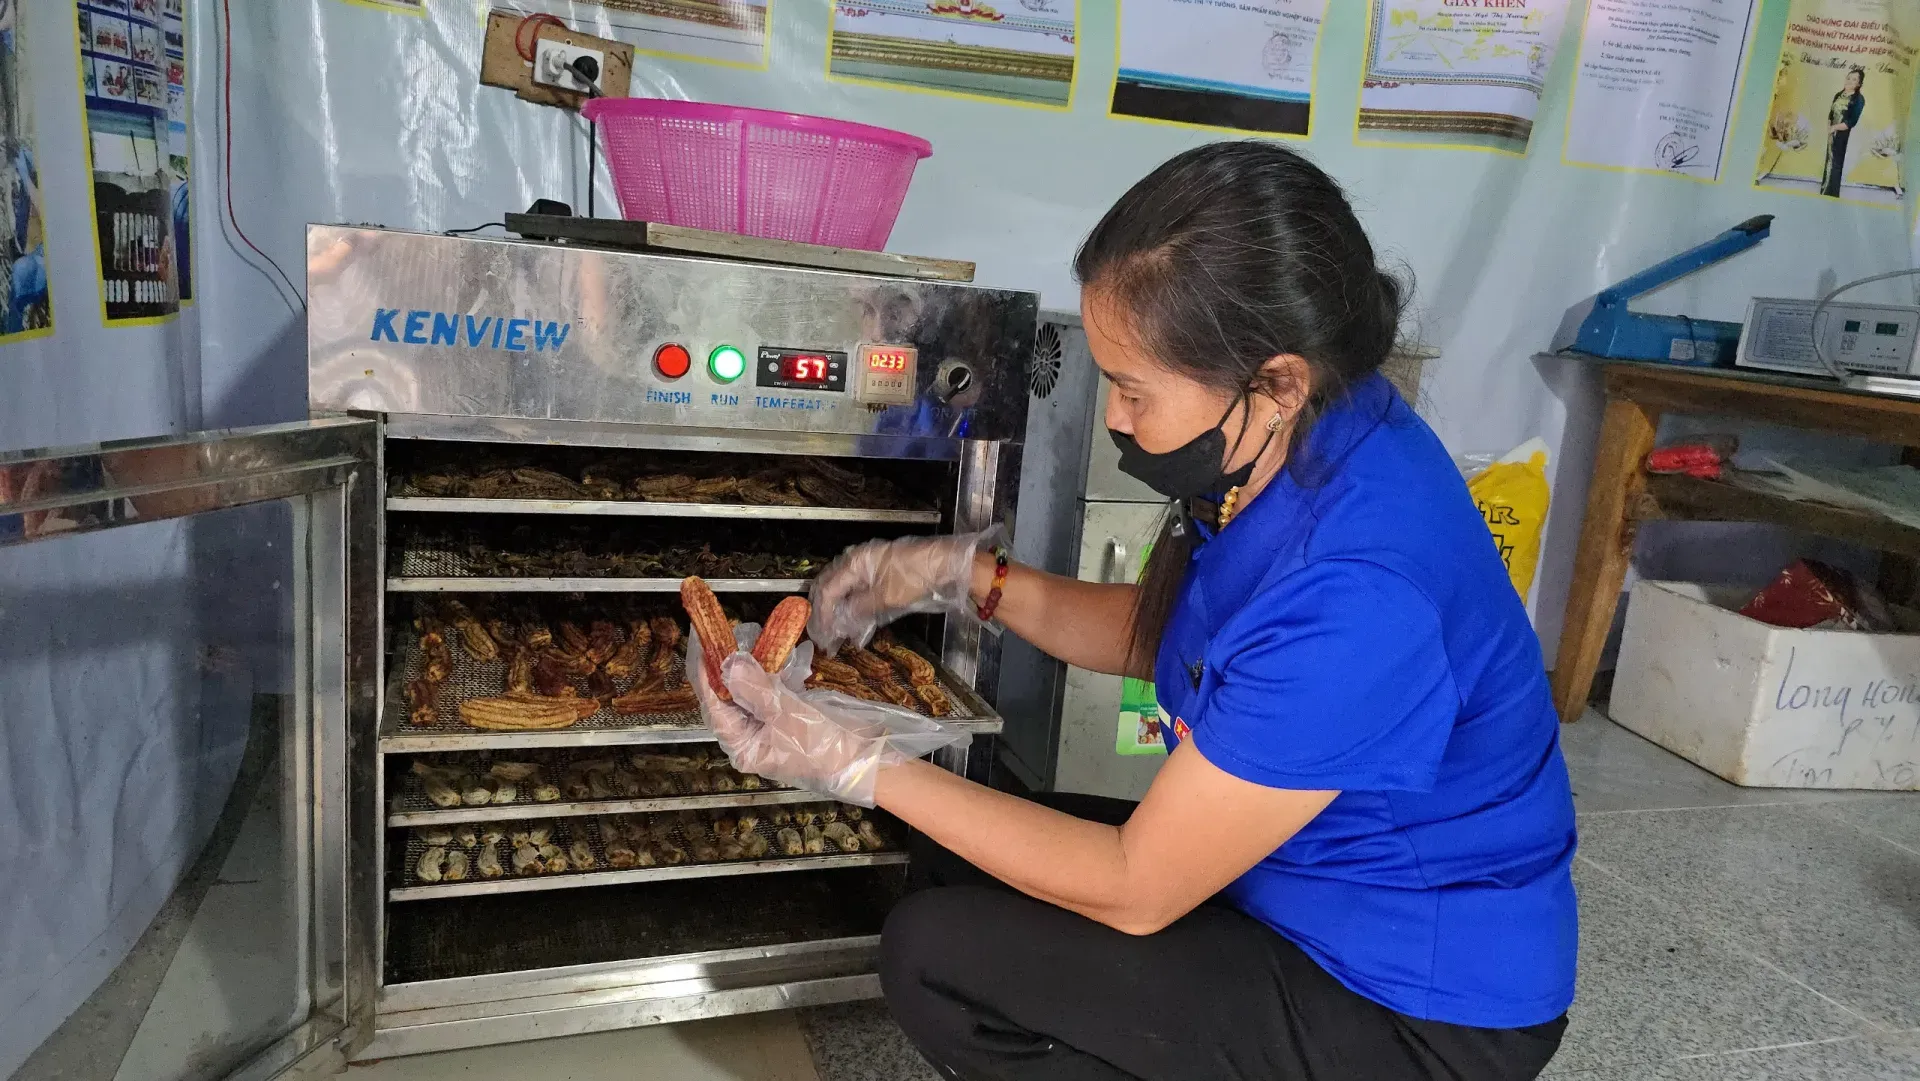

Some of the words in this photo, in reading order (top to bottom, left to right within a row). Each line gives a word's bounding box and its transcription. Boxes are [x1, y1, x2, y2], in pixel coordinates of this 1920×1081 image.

[370, 307, 571, 352] KENVIEW
[794, 358, 826, 379] 57
[870, 353, 906, 370] 0233
[645, 389, 692, 405] FINISH
[710, 393, 739, 406] RUN
